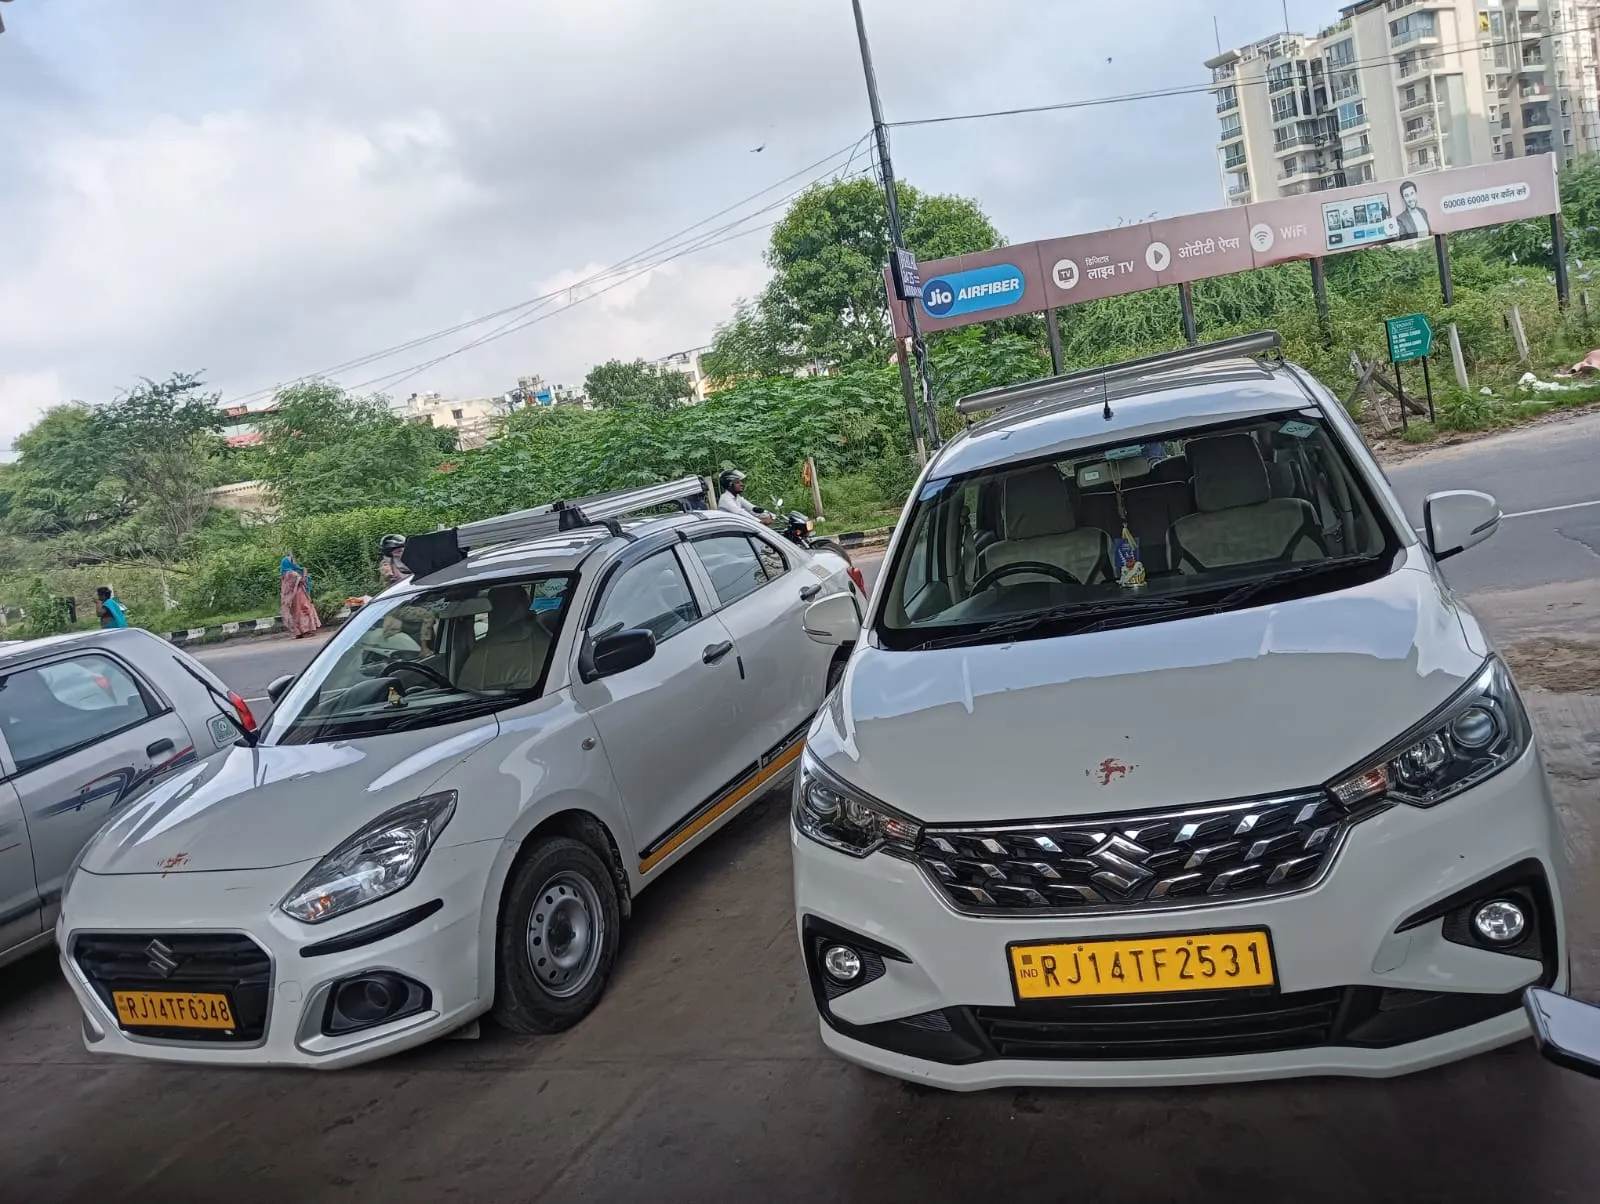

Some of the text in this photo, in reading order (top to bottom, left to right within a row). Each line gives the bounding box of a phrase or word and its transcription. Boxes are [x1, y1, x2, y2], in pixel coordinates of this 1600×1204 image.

[1280, 224, 1308, 240] WiFi
[1178, 236, 1240, 259] ओटीटी ऐप्स
[1085, 255, 1110, 267] डिजिटल
[1086, 260, 1134, 280] लाइव TV
[1060, 269, 1072, 278] TV
[927, 278, 1020, 307] Jio AIRFIBER
[1020, 967, 1039, 979] IND
[1040, 941, 1261, 988] RJ14TF2531
[126, 998, 229, 1022] RJ14TF6348
